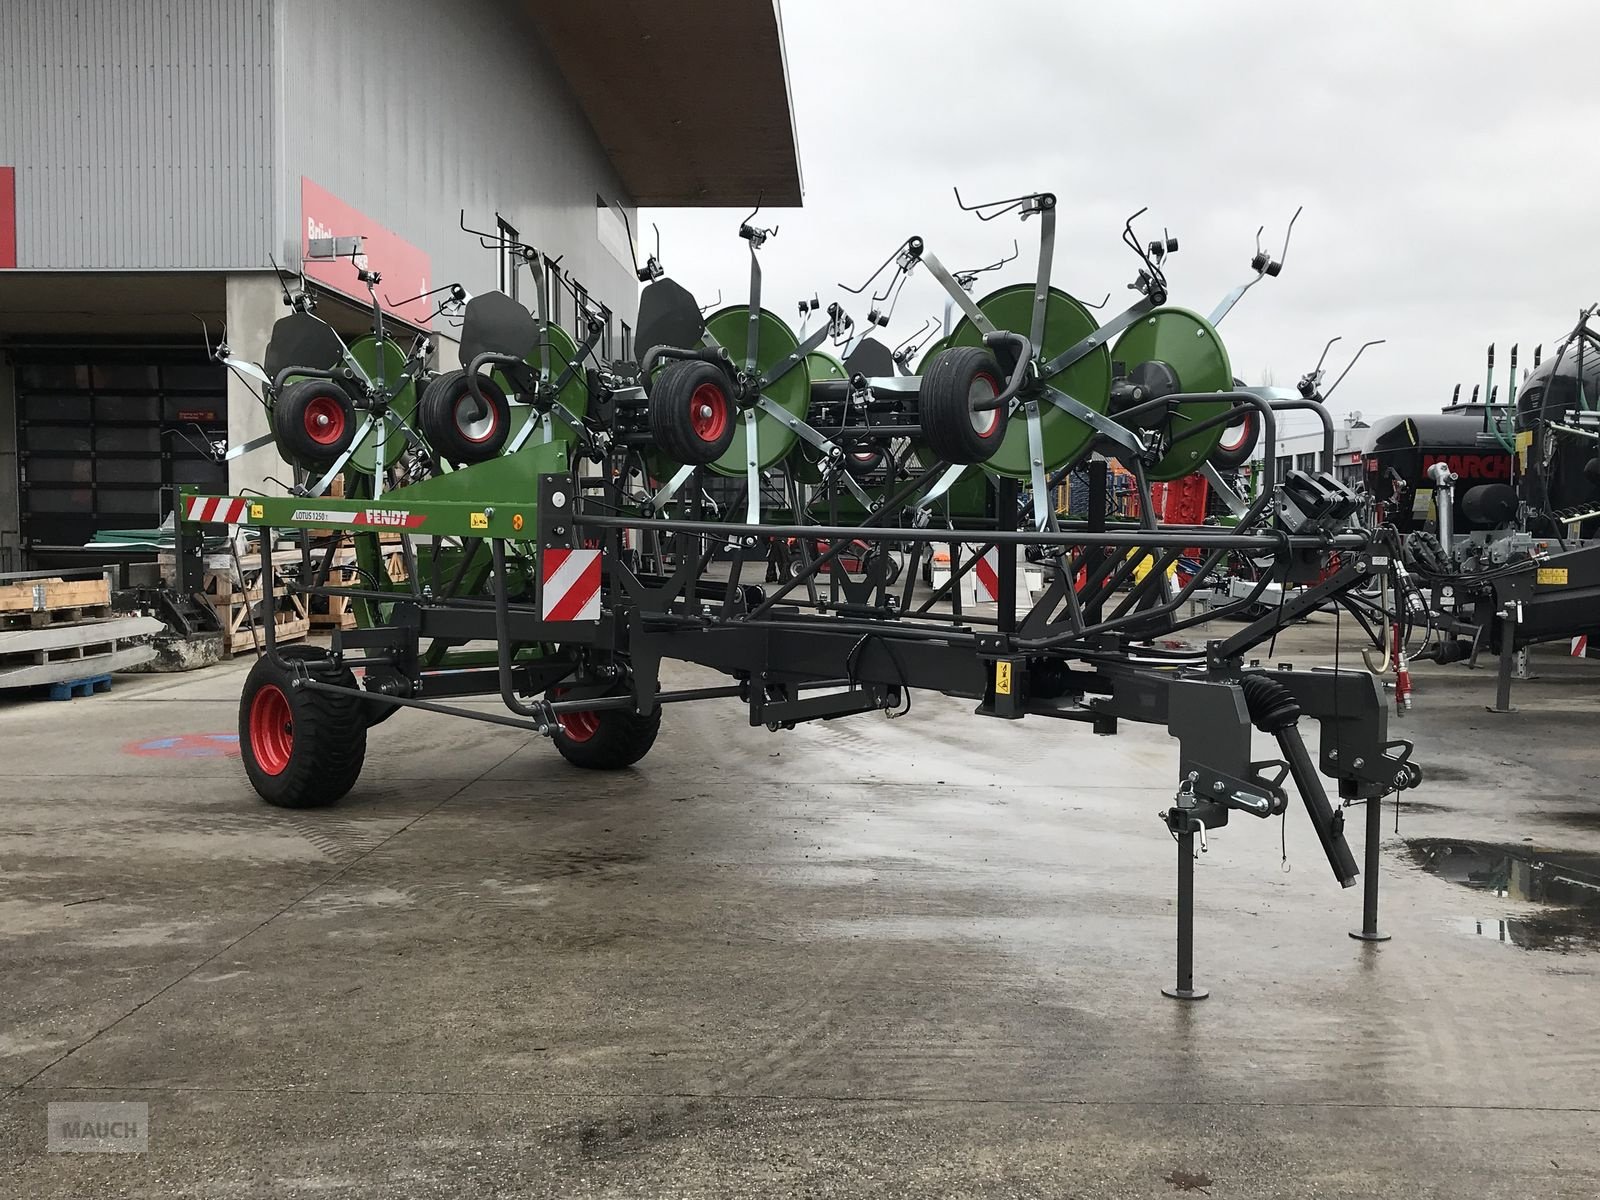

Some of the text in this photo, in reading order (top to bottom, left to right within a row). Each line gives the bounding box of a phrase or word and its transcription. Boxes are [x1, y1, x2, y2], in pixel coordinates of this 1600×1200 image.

[296, 512, 312, 520] LOTUS
[313, 513, 325, 521] 1250
[366, 509, 410, 526] FENDT
